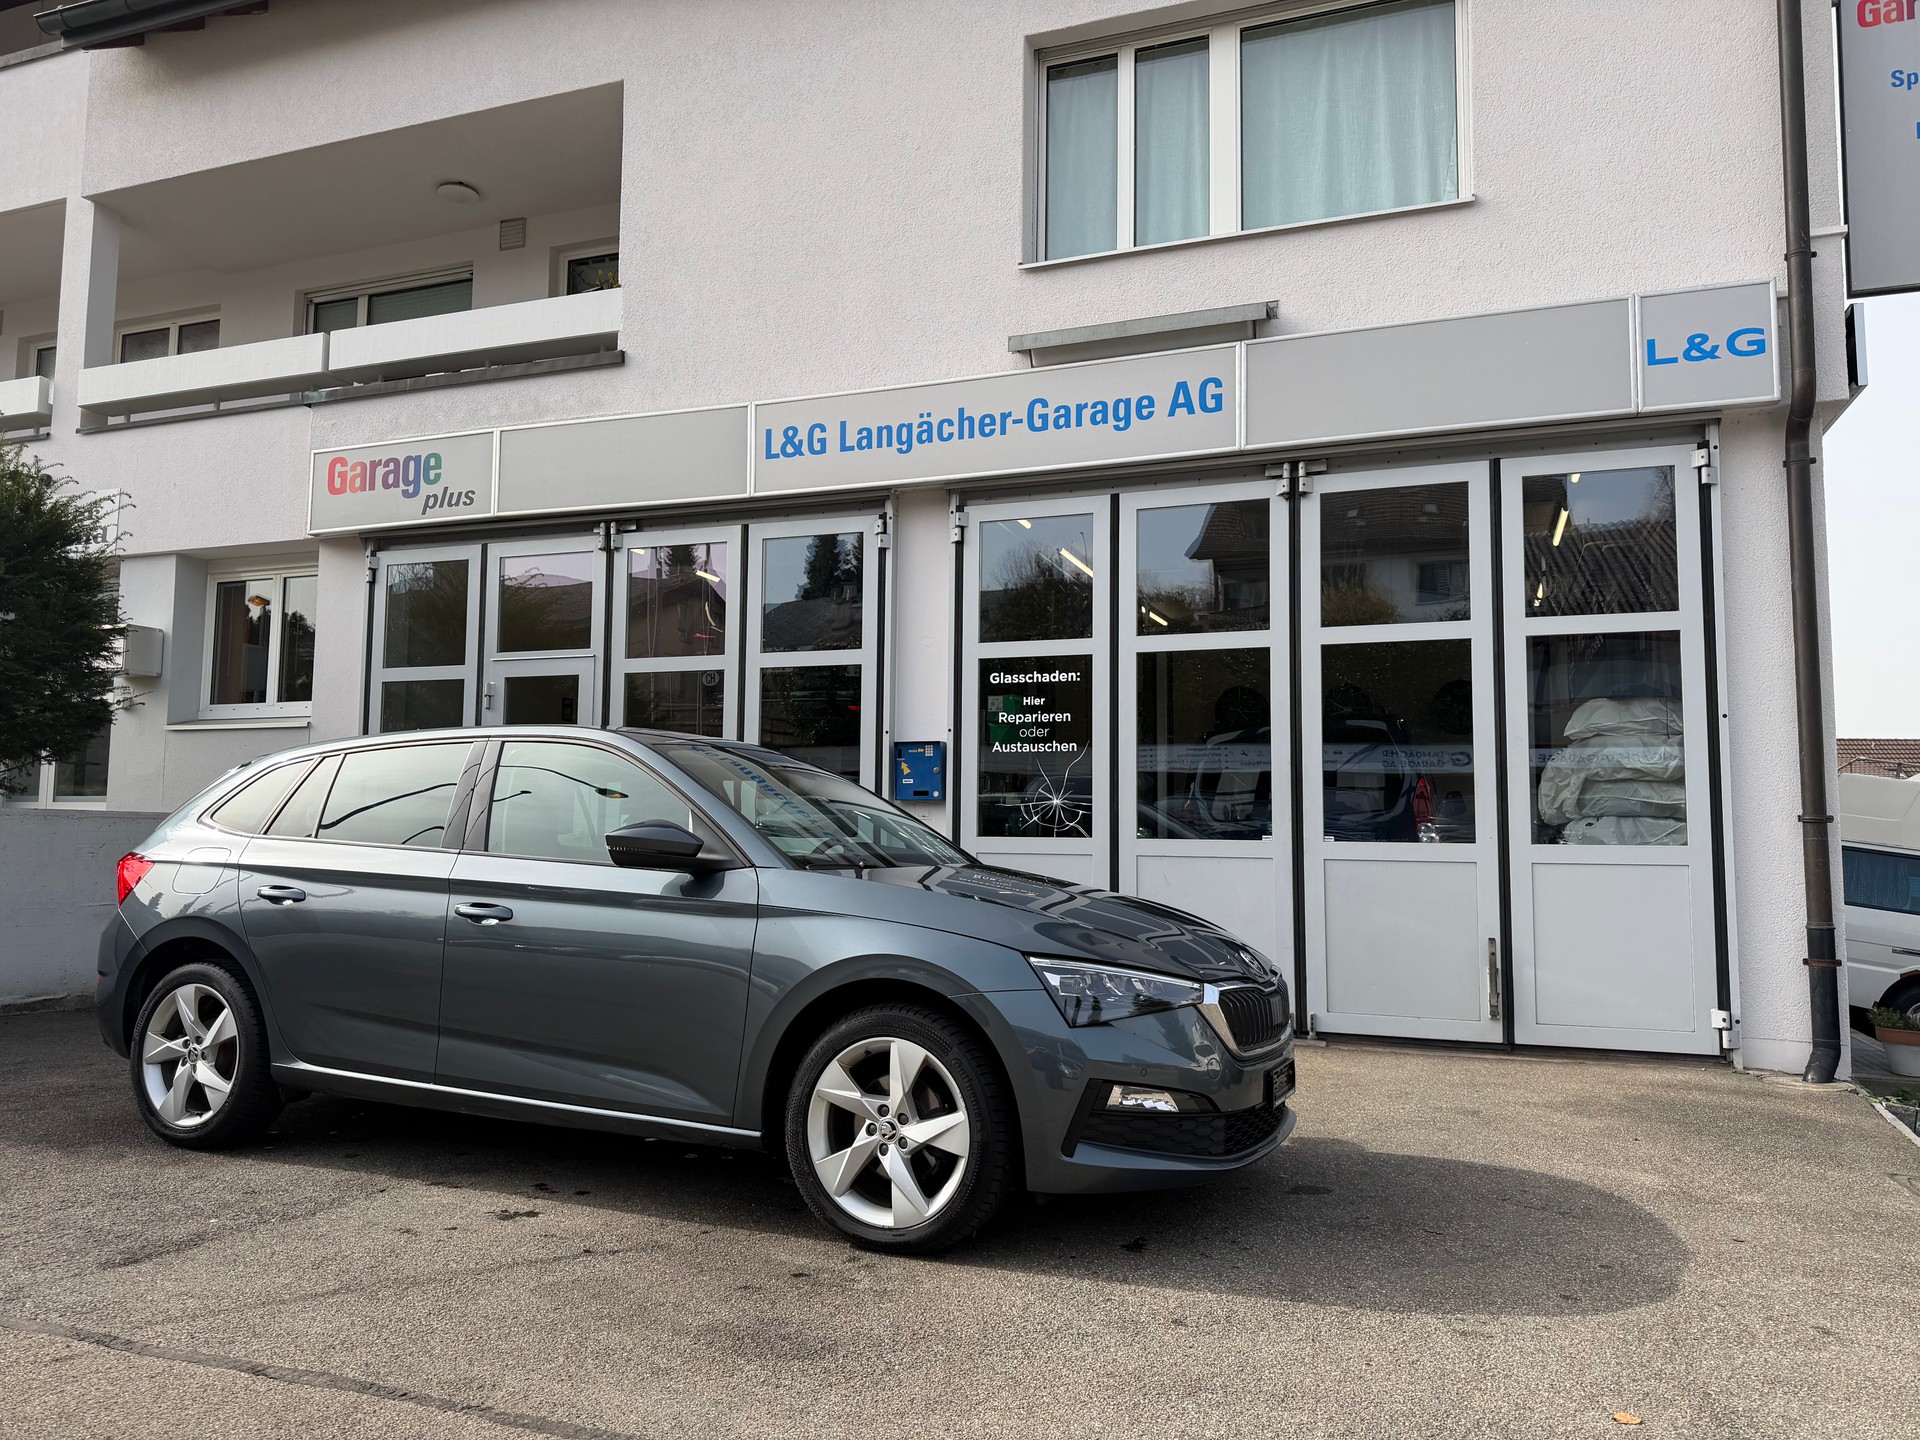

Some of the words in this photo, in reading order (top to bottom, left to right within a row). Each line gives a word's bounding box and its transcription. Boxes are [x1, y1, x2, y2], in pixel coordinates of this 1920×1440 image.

[1646, 327, 1766, 366] L&G
[765, 422, 828, 460] L&G
[839, 394, 1156, 454] Langächer-Garage
[1167, 376, 1224, 418] AG
[327, 452, 443, 499] Garage
[421, 486, 476, 515] plus
[705, 673, 716, 685] CH
[989, 670, 1081, 684] Glasschaden:
[1022, 696, 1046, 706] Hier
[998, 711, 1071, 724] Reparieren
[1019, 726, 1050, 738] oder
[991, 740, 1078, 753] Austauschen
